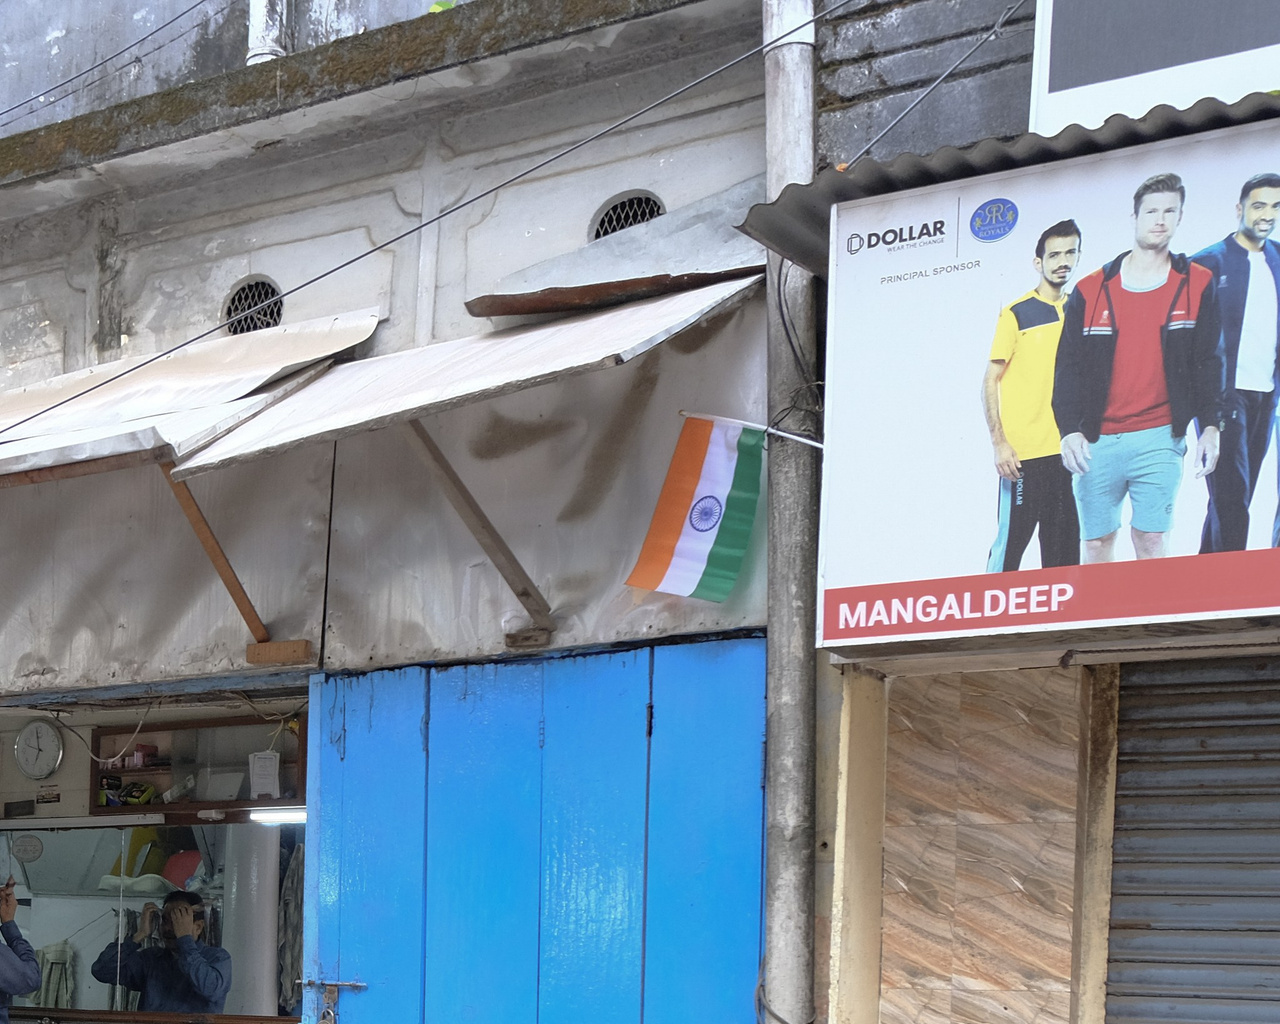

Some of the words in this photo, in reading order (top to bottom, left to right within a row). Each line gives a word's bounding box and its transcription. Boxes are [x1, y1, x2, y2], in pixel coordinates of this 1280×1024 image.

[867, 219, 946, 249] DOLLAR
[918, 237, 945, 247] CHANGE
[979, 226, 1010, 237] ROYALS
[880, 269, 930, 285] PRINCIPAL
[932, 260, 981, 276] SPONSOR
[838, 583, 1074, 629] MANGALDEEP
